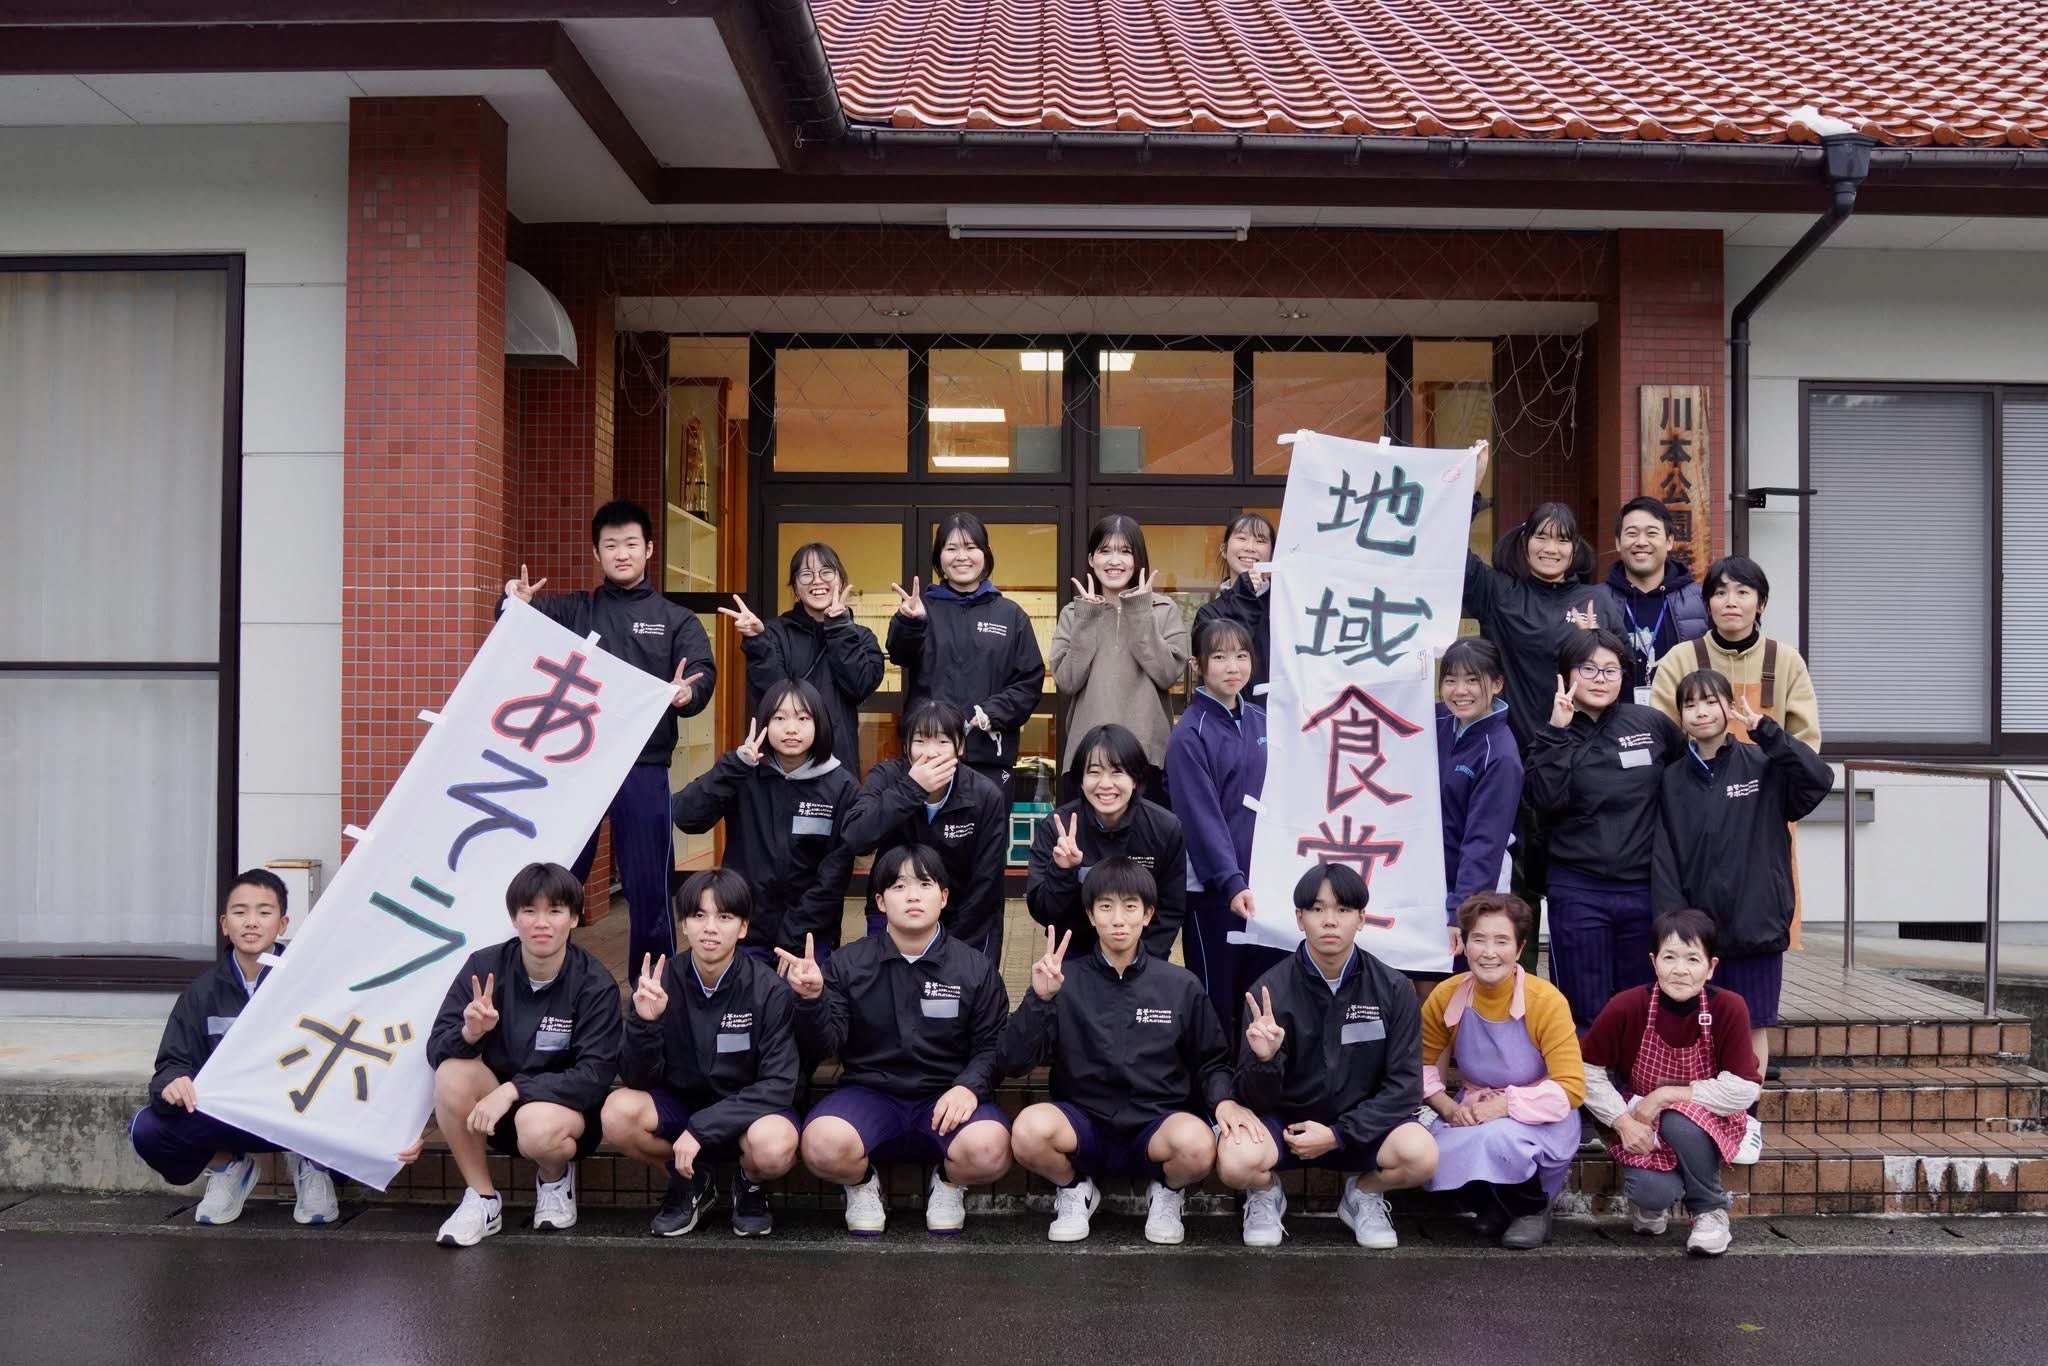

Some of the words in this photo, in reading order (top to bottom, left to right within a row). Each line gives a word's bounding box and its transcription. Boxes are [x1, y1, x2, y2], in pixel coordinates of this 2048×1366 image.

[1295, 464, 1433, 929] 地域食堂
[1660, 397, 1692, 565] 川本公
[277, 651, 603, 1114] あそラボ
